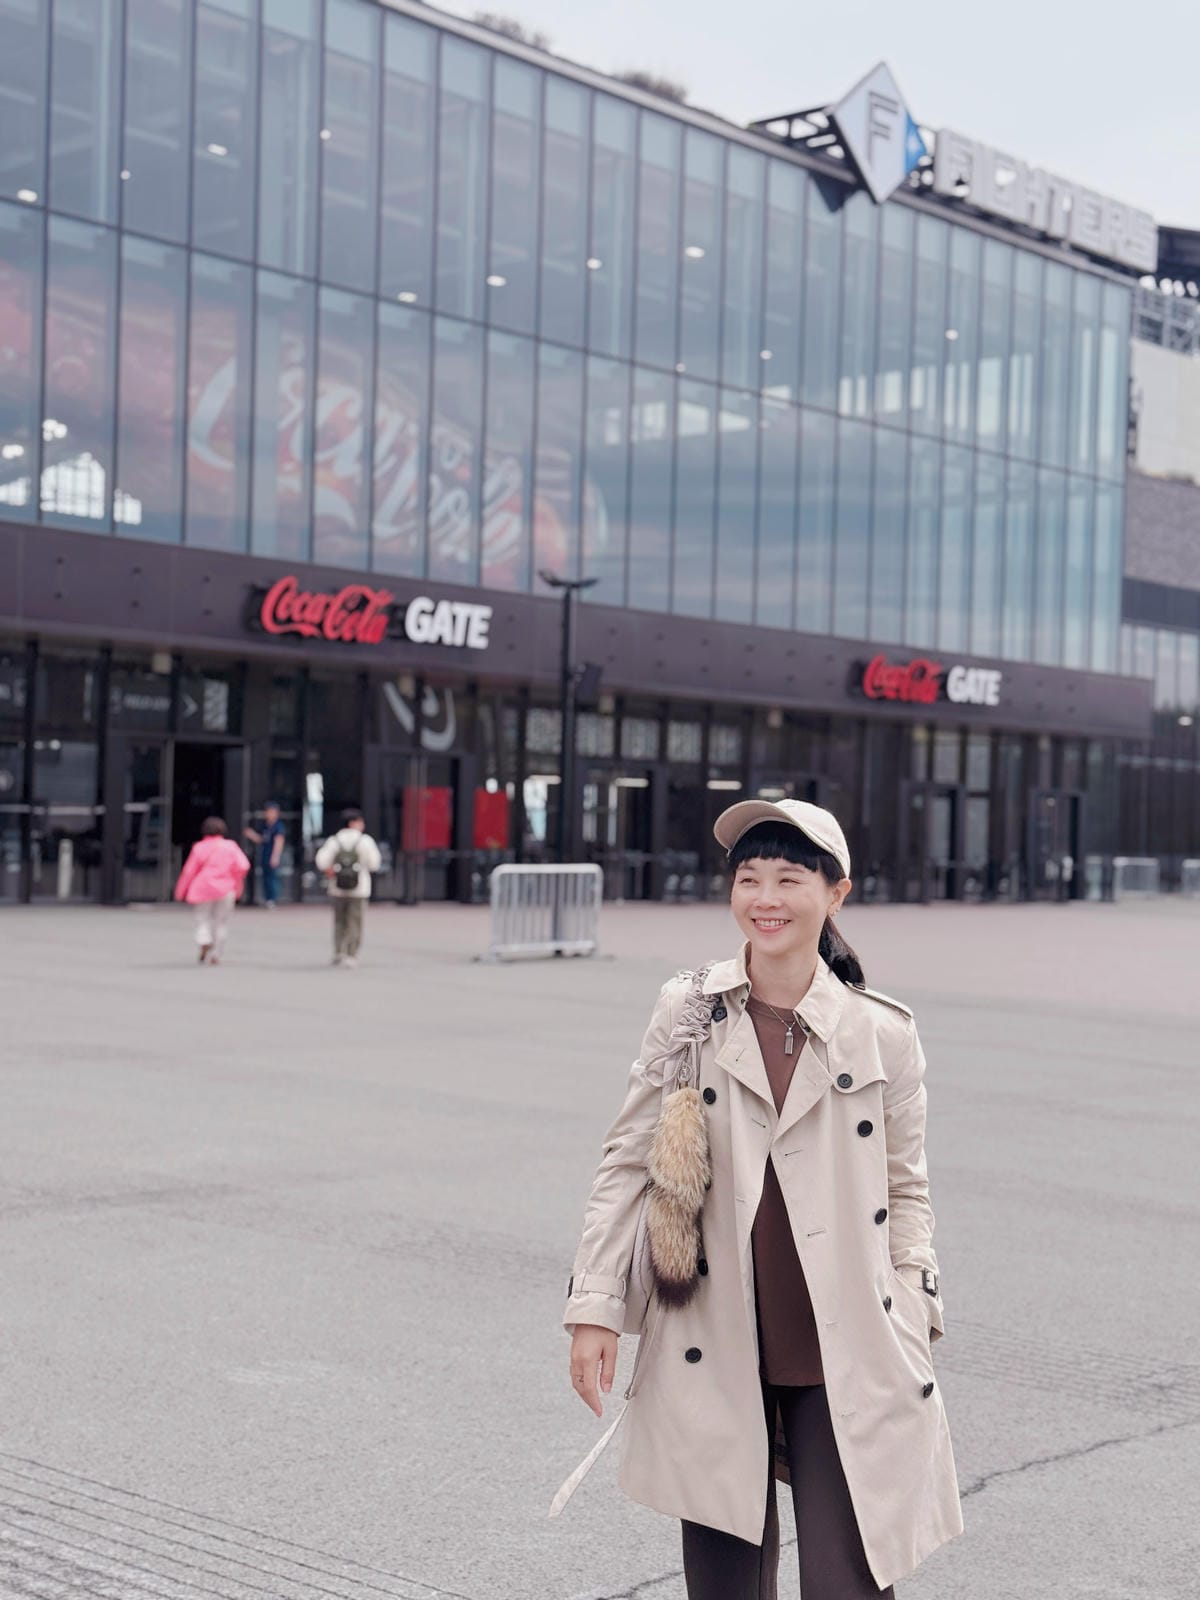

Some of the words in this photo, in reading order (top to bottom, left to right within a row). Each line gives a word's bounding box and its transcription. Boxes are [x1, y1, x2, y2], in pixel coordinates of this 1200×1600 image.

[867, 90, 898, 173] F
[261, 575, 394, 644] Coca-Cola
[405, 596, 493, 649] GATE
[947, 665, 1003, 706] GATE
